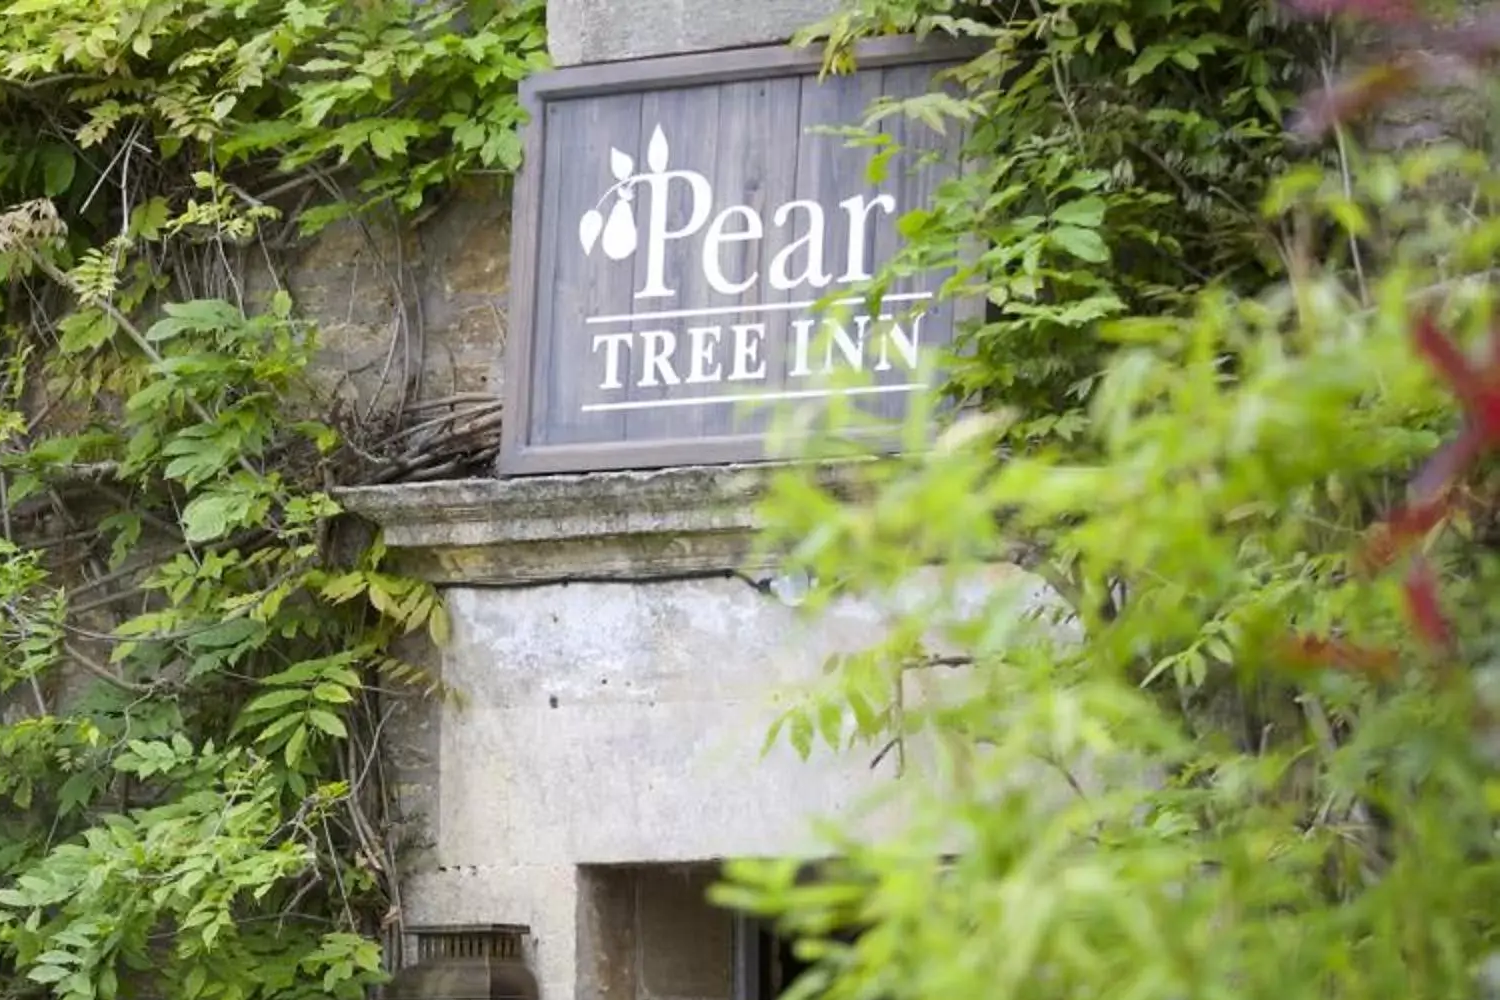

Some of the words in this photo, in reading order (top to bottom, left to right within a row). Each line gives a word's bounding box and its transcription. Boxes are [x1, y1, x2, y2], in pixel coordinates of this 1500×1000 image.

[634, 170, 895, 299] Pear
[593, 322, 767, 390] TREE
[788, 312, 926, 378] INN
